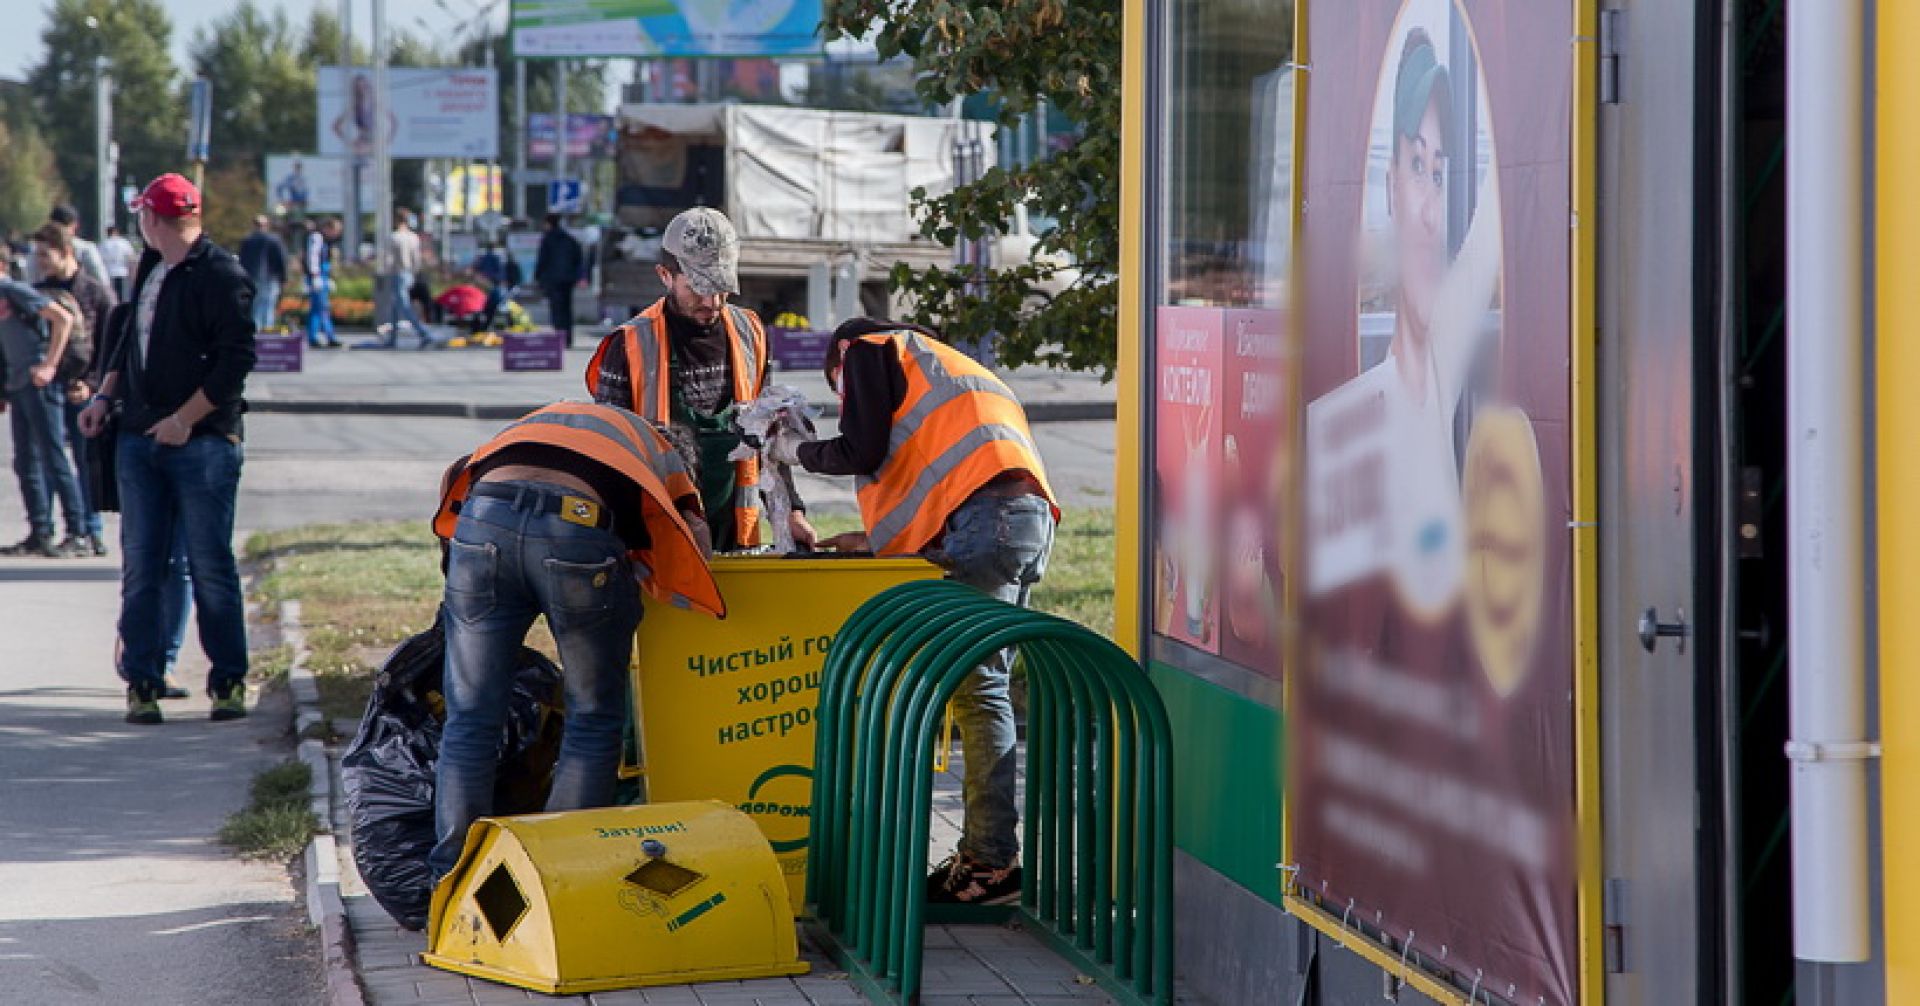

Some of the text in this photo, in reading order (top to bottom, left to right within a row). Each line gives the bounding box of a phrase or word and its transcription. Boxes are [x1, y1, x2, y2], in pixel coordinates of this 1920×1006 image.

[688, 635, 832, 676] Чистый го
[737, 670, 822, 704] хорош
[718, 706, 818, 745] настро
